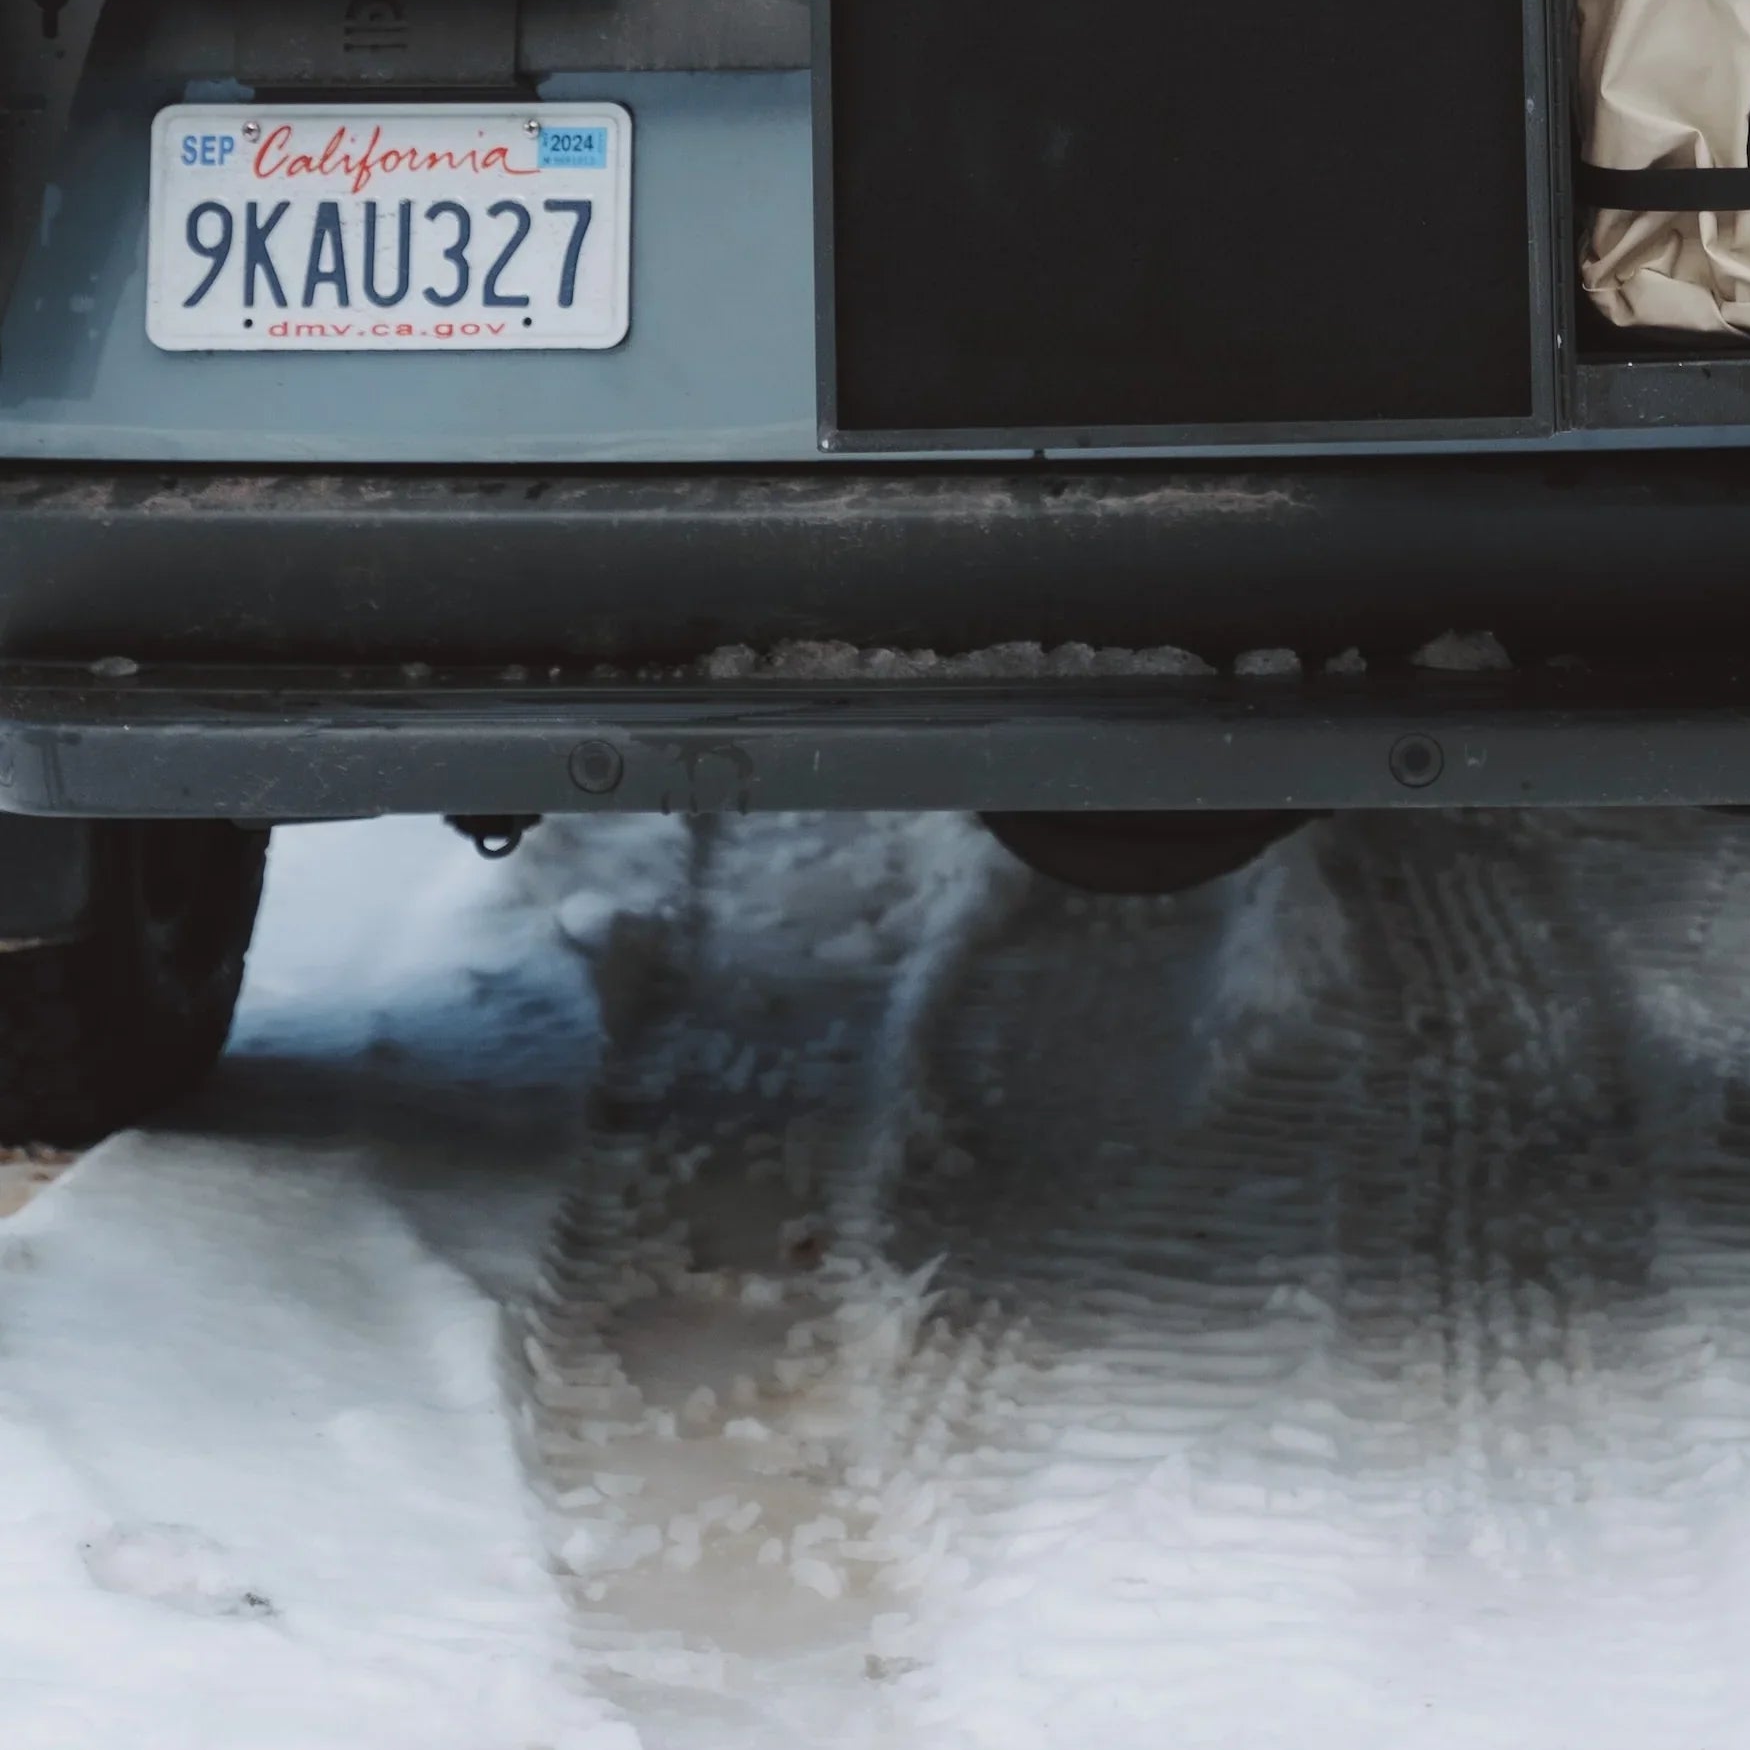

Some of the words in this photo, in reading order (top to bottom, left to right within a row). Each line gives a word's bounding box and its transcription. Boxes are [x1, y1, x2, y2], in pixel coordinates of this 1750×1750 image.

[181, 135, 235, 166] SEP
[252, 124, 541, 193] California
[551, 134, 594, 152] 2024
[182, 200, 593, 308] 9KAU327
[268, 321, 507, 339] dmv.ca.gov
